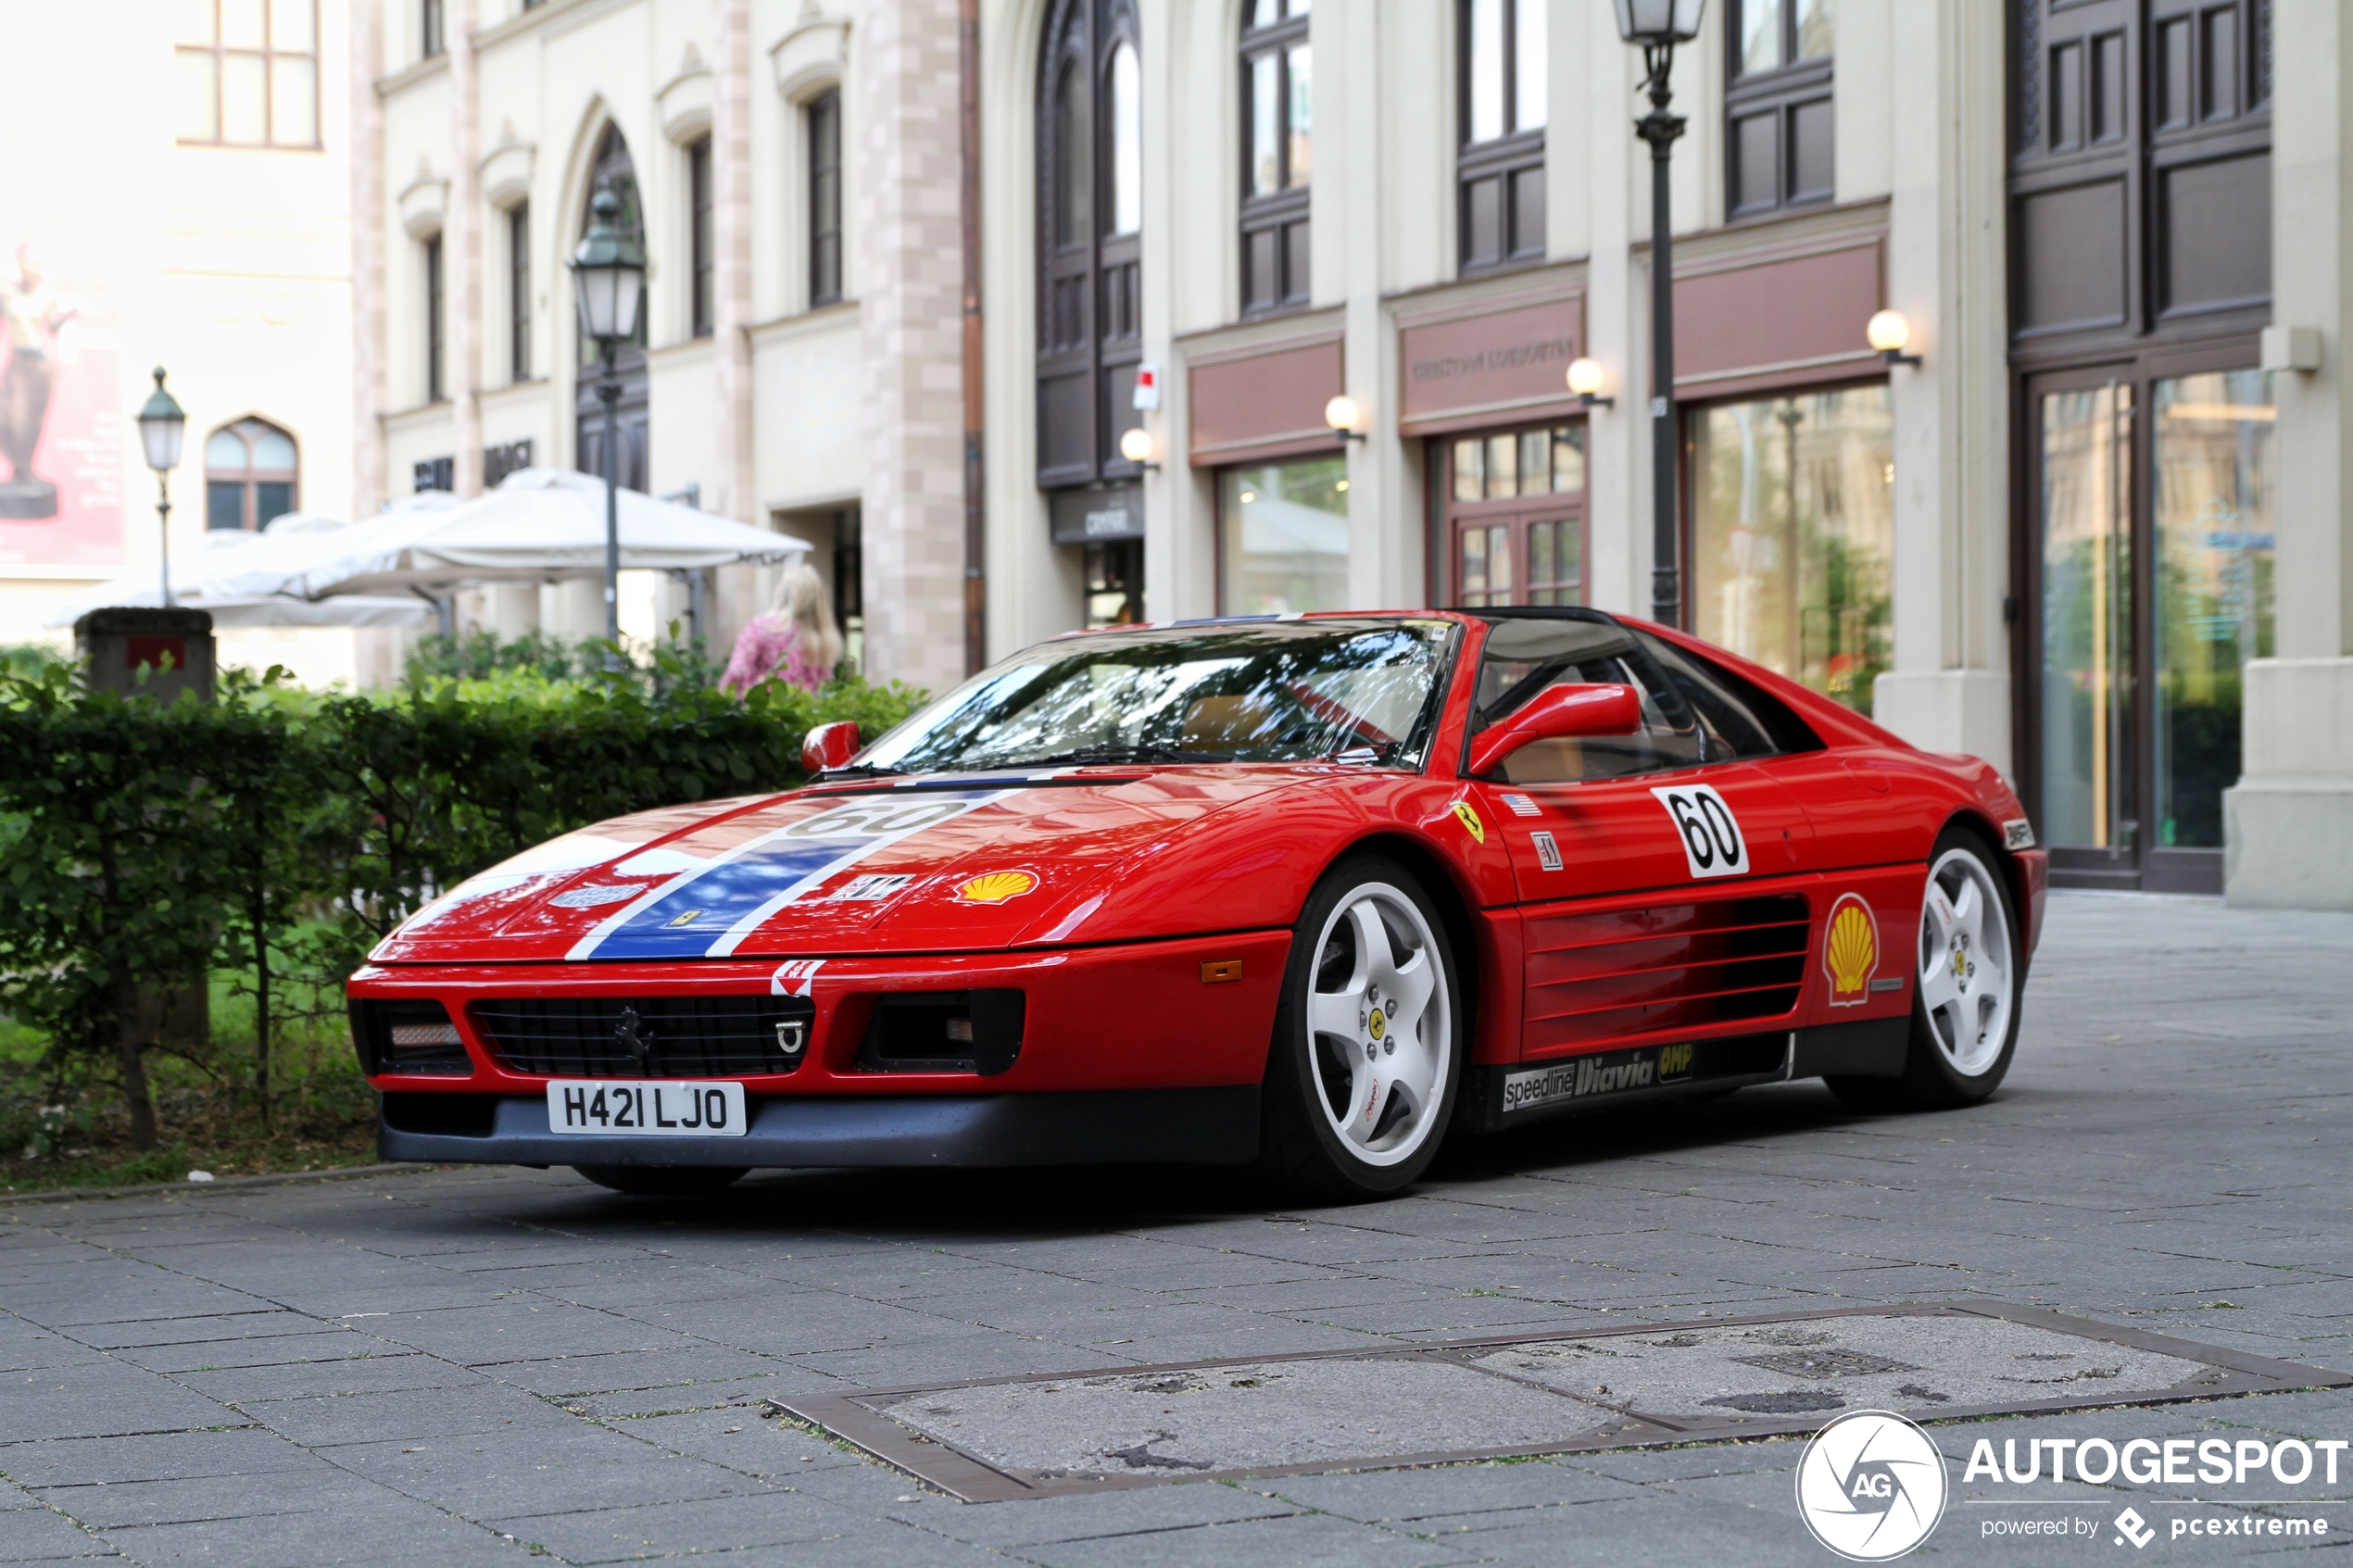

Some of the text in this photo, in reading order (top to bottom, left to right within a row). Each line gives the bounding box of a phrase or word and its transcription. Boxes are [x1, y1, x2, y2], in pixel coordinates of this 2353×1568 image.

[786, 802, 967, 837] 60
[1668, 792, 1740, 870] 60
[788, 960, 811, 979] TOW
[1660, 1044, 1692, 1075] OMP
[1505, 1052, 1655, 1110] speedline Diavia
[563, 1087, 727, 1129] H421 LJO
